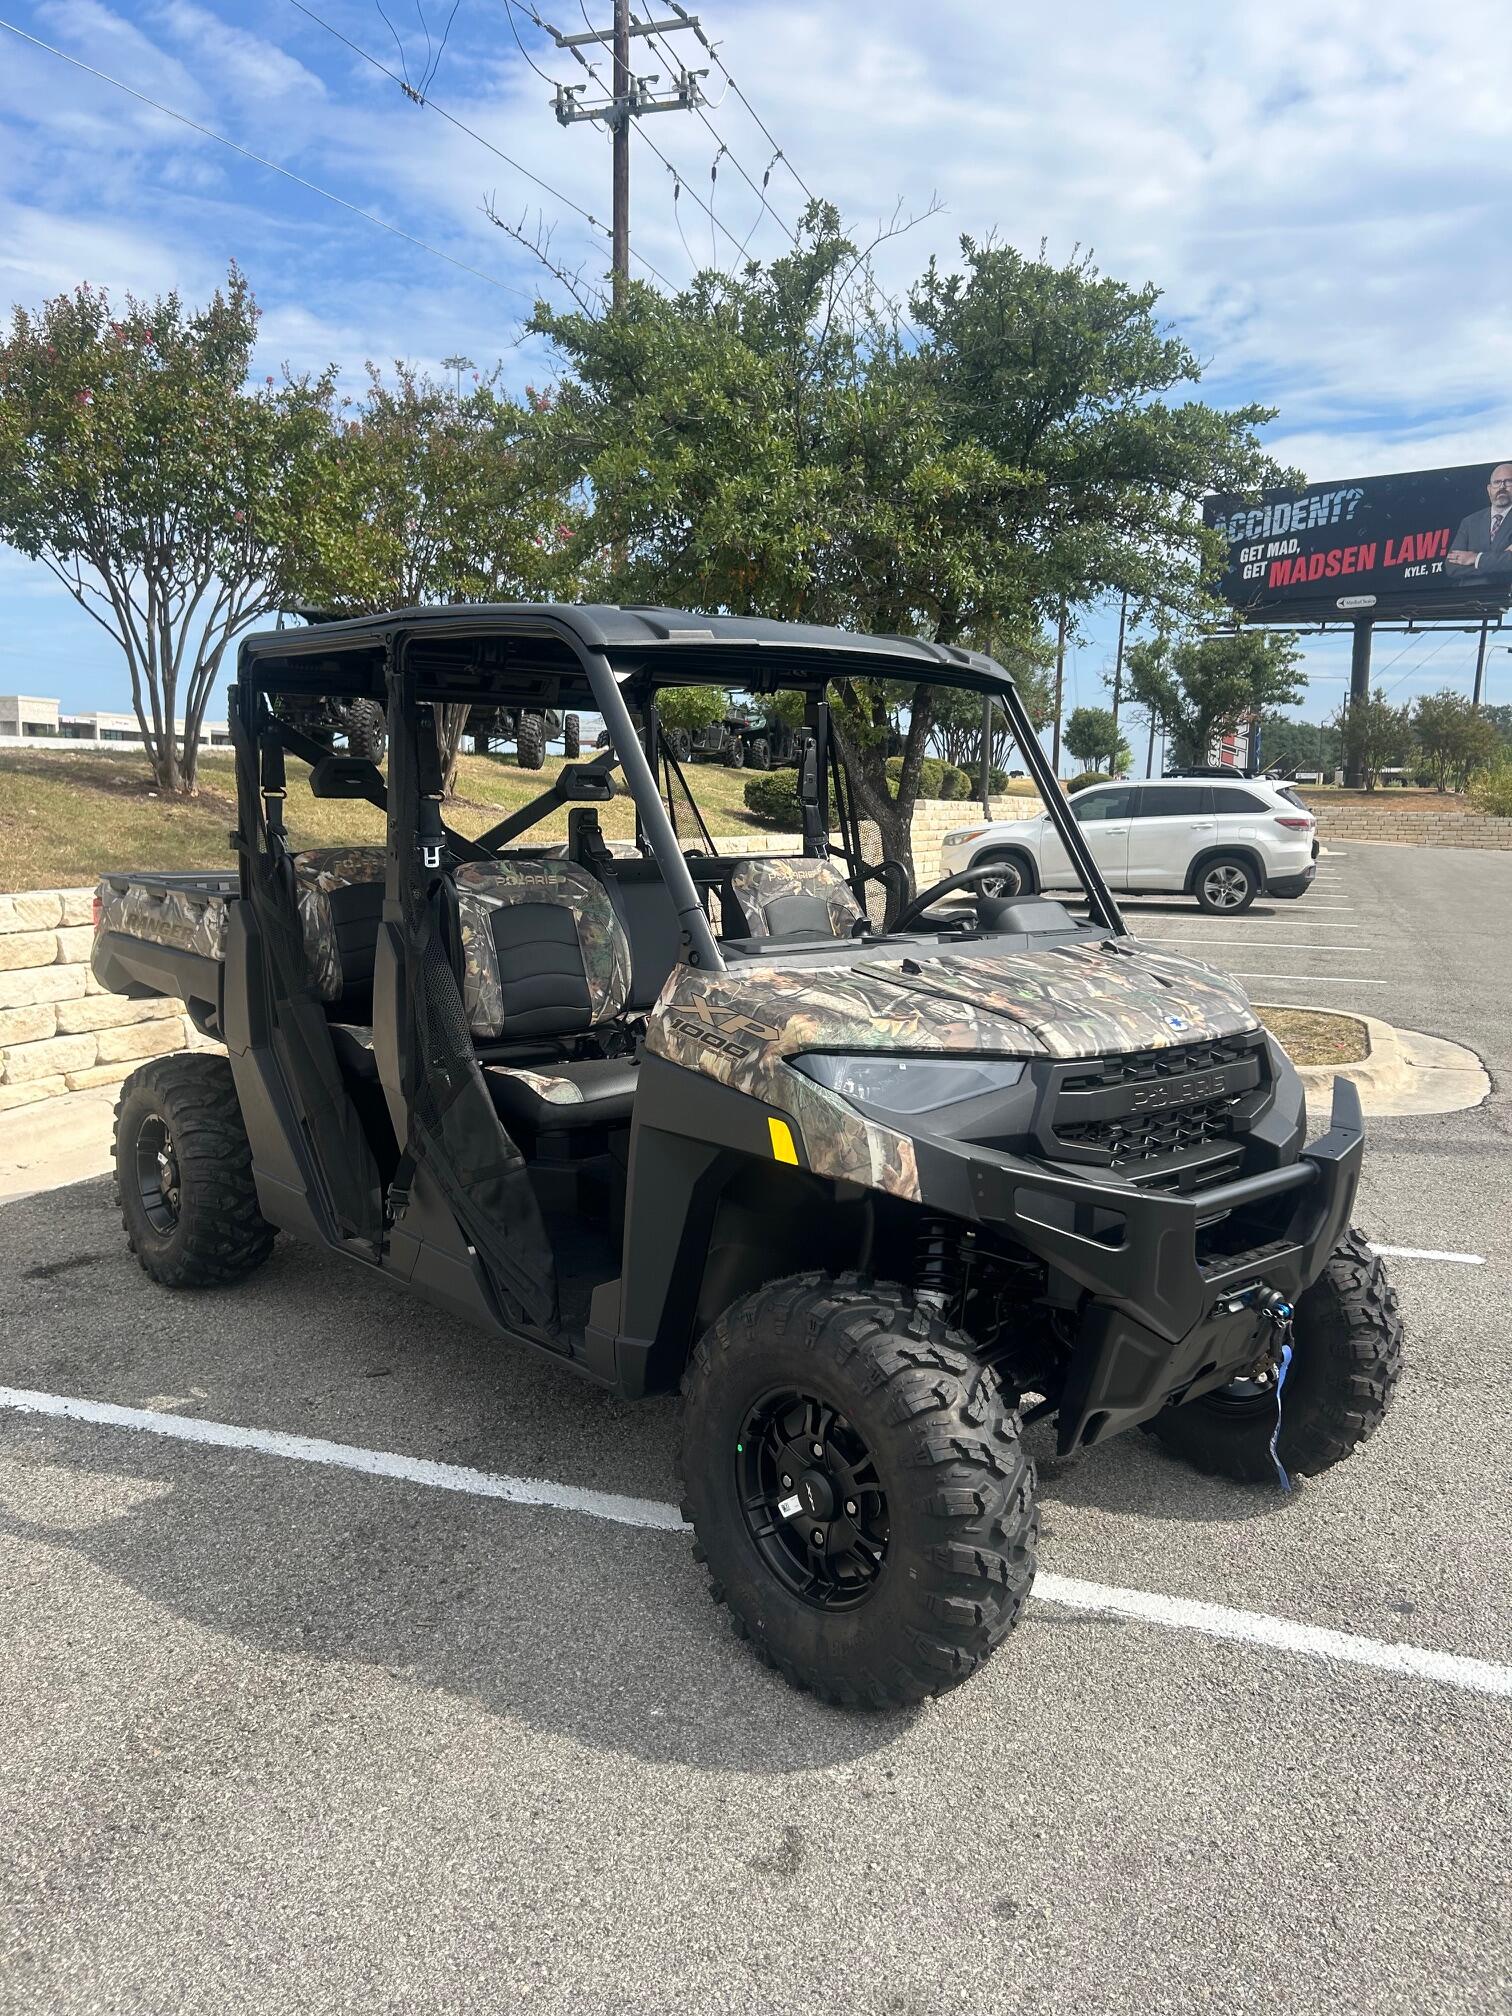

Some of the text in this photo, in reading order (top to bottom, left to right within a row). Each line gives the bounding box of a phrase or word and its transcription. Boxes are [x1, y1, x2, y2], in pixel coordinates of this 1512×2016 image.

[1214, 487, 1364, 544] ACCIDENT?
[1240, 538, 1300, 563] GET MAD,
[1243, 528, 1450, 589] GET MADSEN LAW!
[1404, 561, 1444, 578] KYLE, TX
[496, 874, 559, 887] POLARIS
[127, 913, 194, 939] RANGER
[665, 991, 780, 1041] XP
[671, 1019, 750, 1059] 1000
[1131, 1075, 1225, 1111] POLARIS
